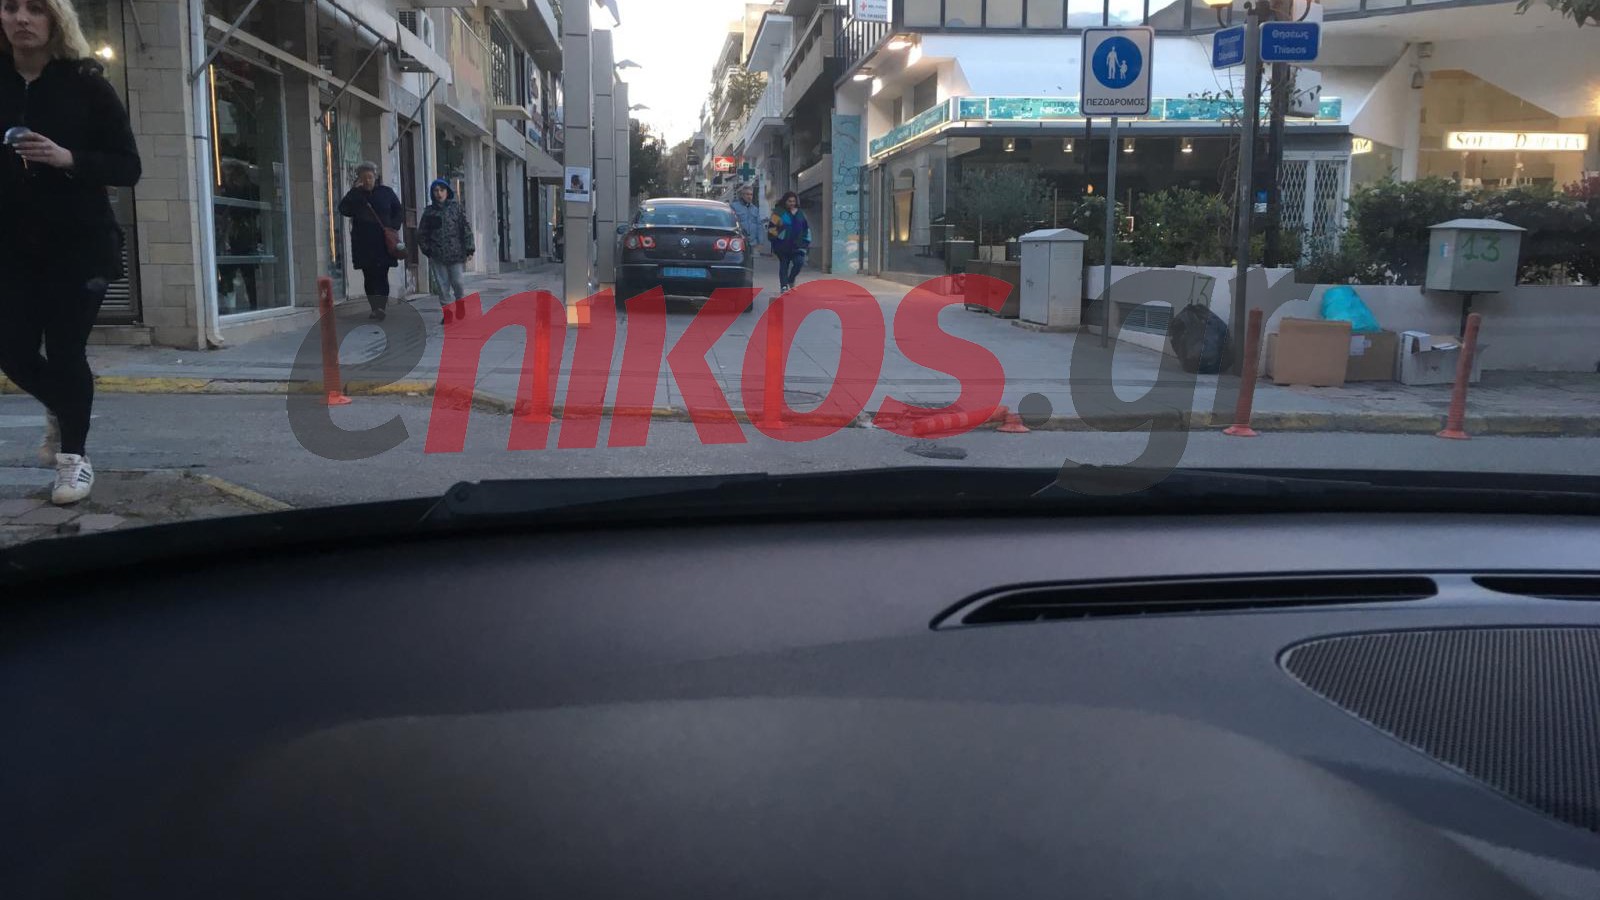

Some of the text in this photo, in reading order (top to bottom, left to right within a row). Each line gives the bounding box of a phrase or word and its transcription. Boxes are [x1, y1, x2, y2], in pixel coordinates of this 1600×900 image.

[1272, 45, 1307, 54] Thiseos
[1086, 97, 1146, 107] ΠΕΖΟΔΡΟΜΟΣ
[1461, 231, 1501, 262] 13
